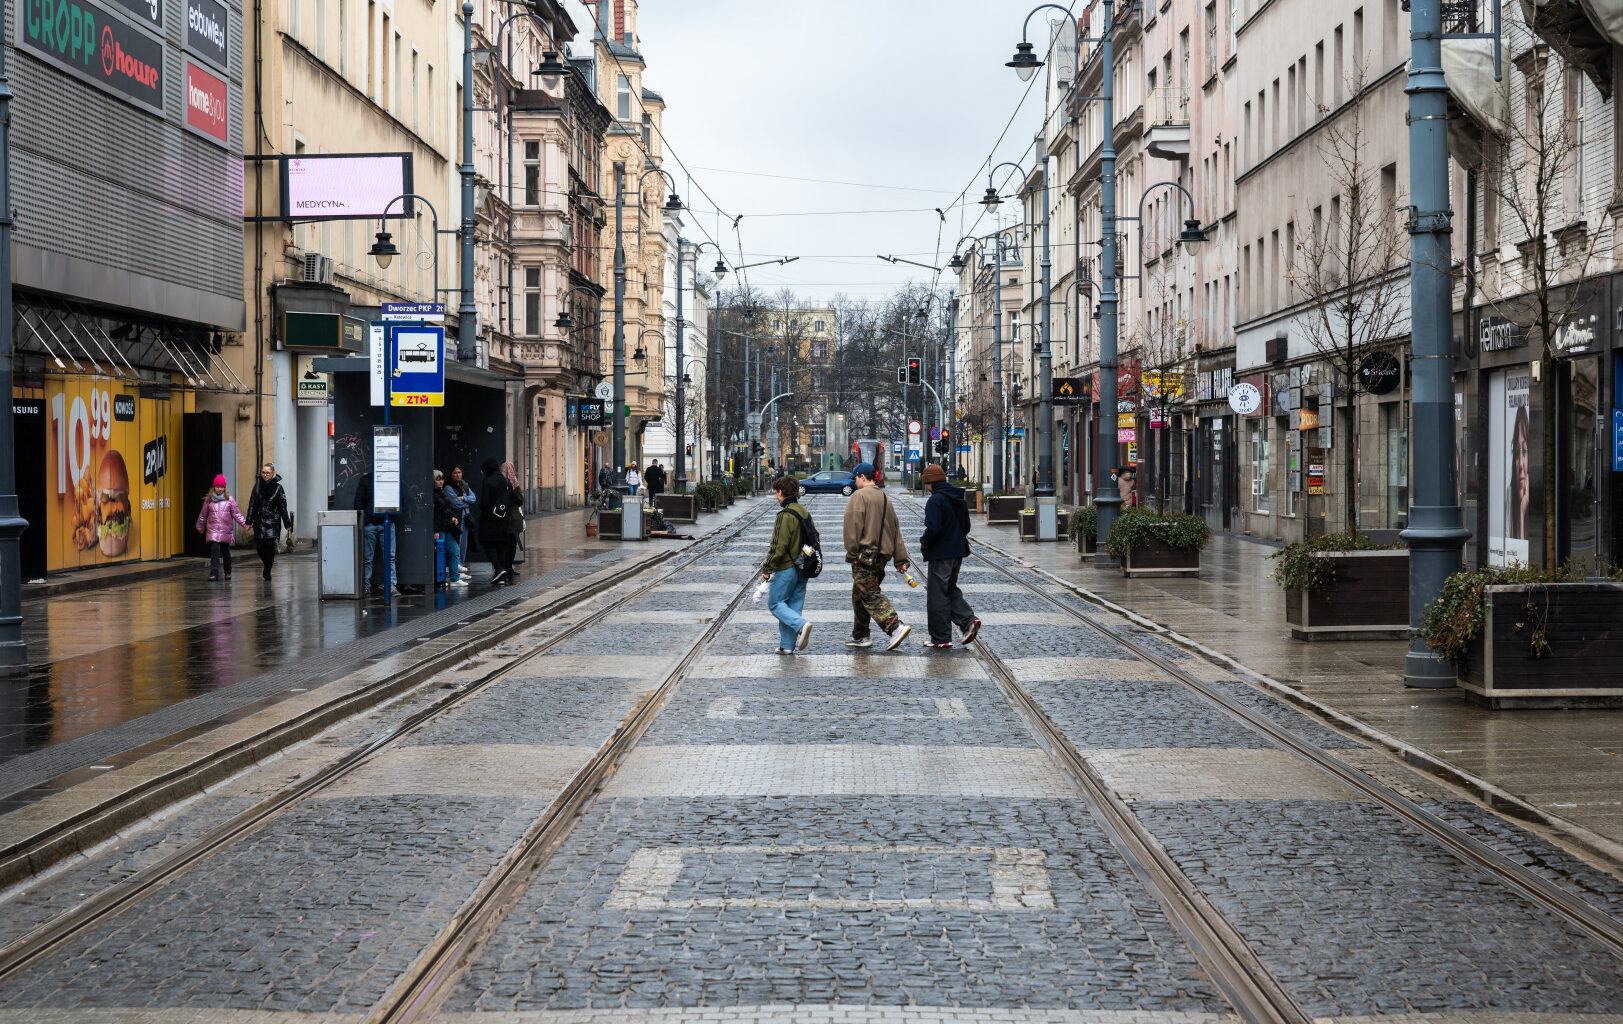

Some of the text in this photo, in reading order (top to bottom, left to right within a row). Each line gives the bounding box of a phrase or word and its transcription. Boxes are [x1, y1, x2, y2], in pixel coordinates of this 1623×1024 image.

[27, 0, 95, 65] CROPP
[189, 4, 225, 50] eobuwie.pl
[115, 41, 159, 90] house
[189, 76, 226, 126] home&you
[407, 395, 429, 404] ZTM
[51, 392, 91, 494] 10
[91, 387, 110, 441] 99
